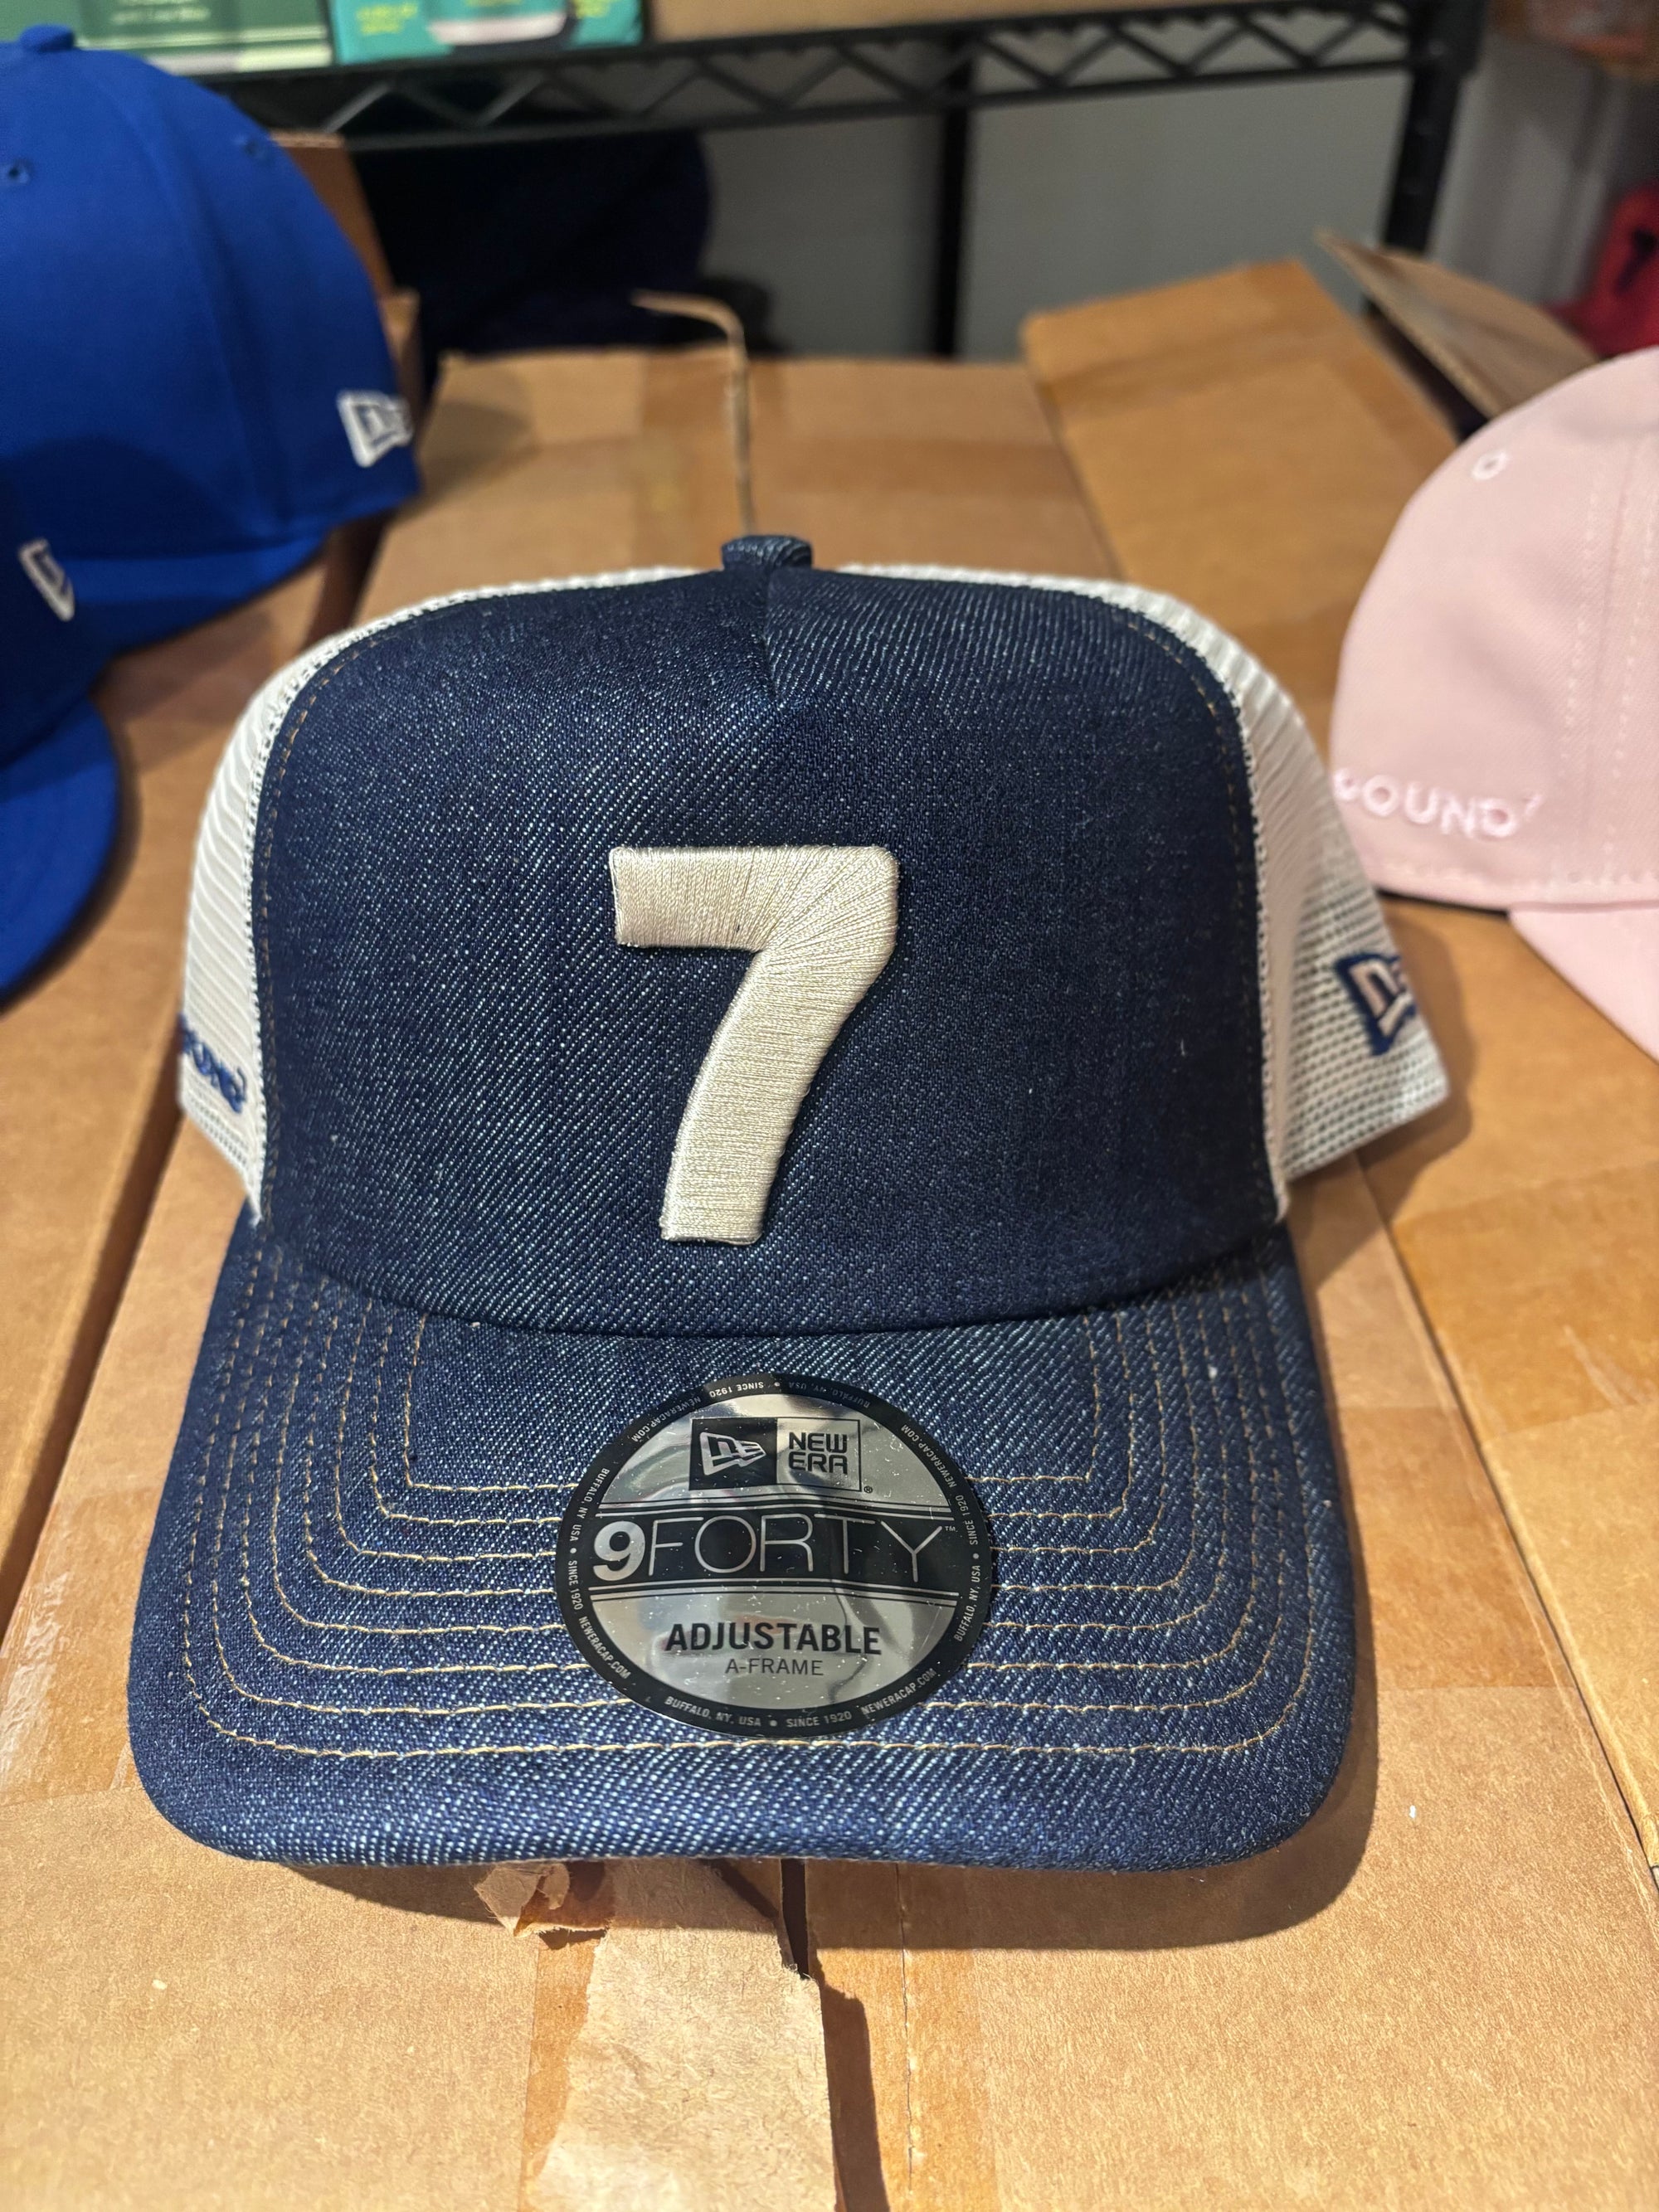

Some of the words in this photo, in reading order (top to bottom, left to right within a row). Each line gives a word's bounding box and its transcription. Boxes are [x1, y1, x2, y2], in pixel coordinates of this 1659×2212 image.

[608, 845, 900, 1245] 7
[709, 1386, 733, 1398] 1920
[737, 1381, 764, 1392] SINCE
[631, 1396, 701, 1442] NEWERACAP.COM
[790, 1432, 847, 1453] NEW
[789, 1451, 847, 1474] ERA
[901, 1424, 957, 1488] NEWERACAP.COM
[956, 1495, 971, 1516] 1920
[570, 1524, 581, 1542] USA
[966, 1519, 978, 1545] SINCE
[593, 1513, 942, 1582] 9FORTY
[568, 1560, 578, 1586] SINCE
[971, 1565, 980, 1582] USA
[570, 1588, 583, 1610] 1920
[579, 1616, 631, 1679] NEWERACAP.COM
[666, 1621, 882, 1655] ADJUSTABLE
[725, 1658, 824, 1676] A-FRAME
[739, 1716, 761, 1726] USA
[786, 1716, 820, 1728] SINCE
[824, 1710, 852, 1723] 1920
[860, 1668, 937, 1715] NEWERACAP.COM
